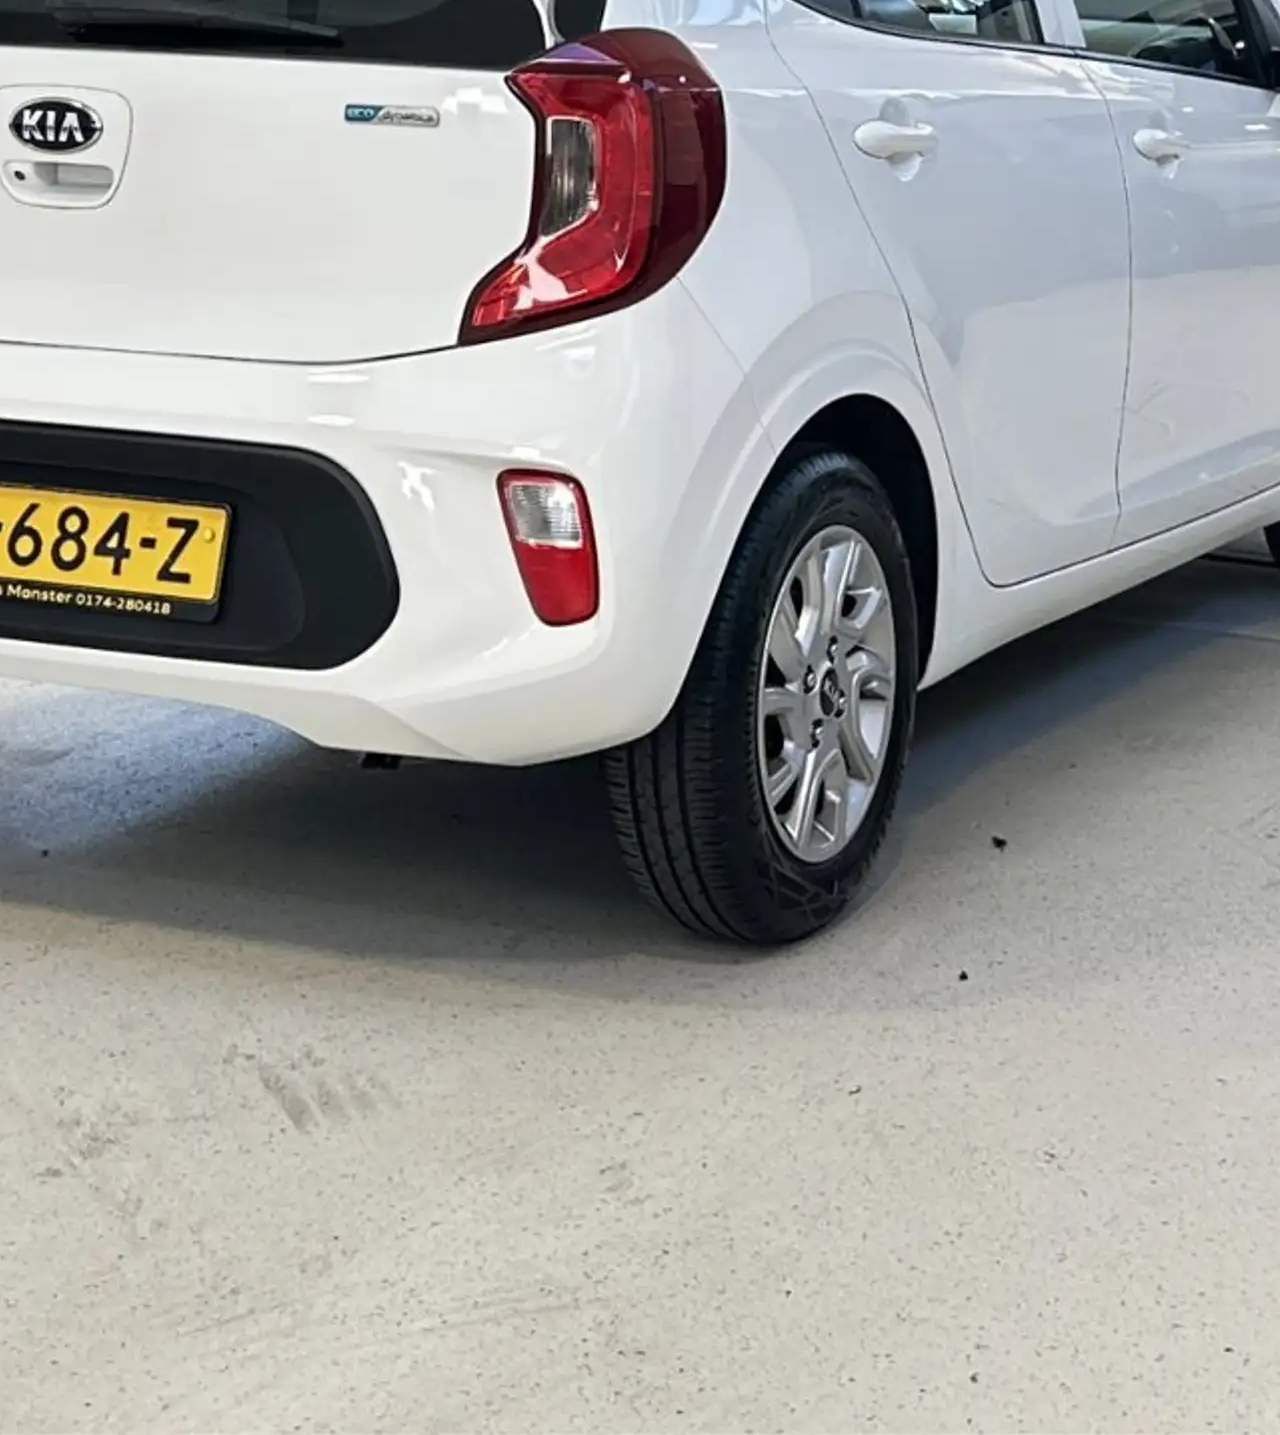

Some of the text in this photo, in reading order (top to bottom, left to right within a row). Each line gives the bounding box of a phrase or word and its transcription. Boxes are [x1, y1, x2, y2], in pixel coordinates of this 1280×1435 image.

[22, 109, 85, 143] KIA
[6, 584, 72, 604] Monster
[75, 592, 171, 615] 0174-280418
